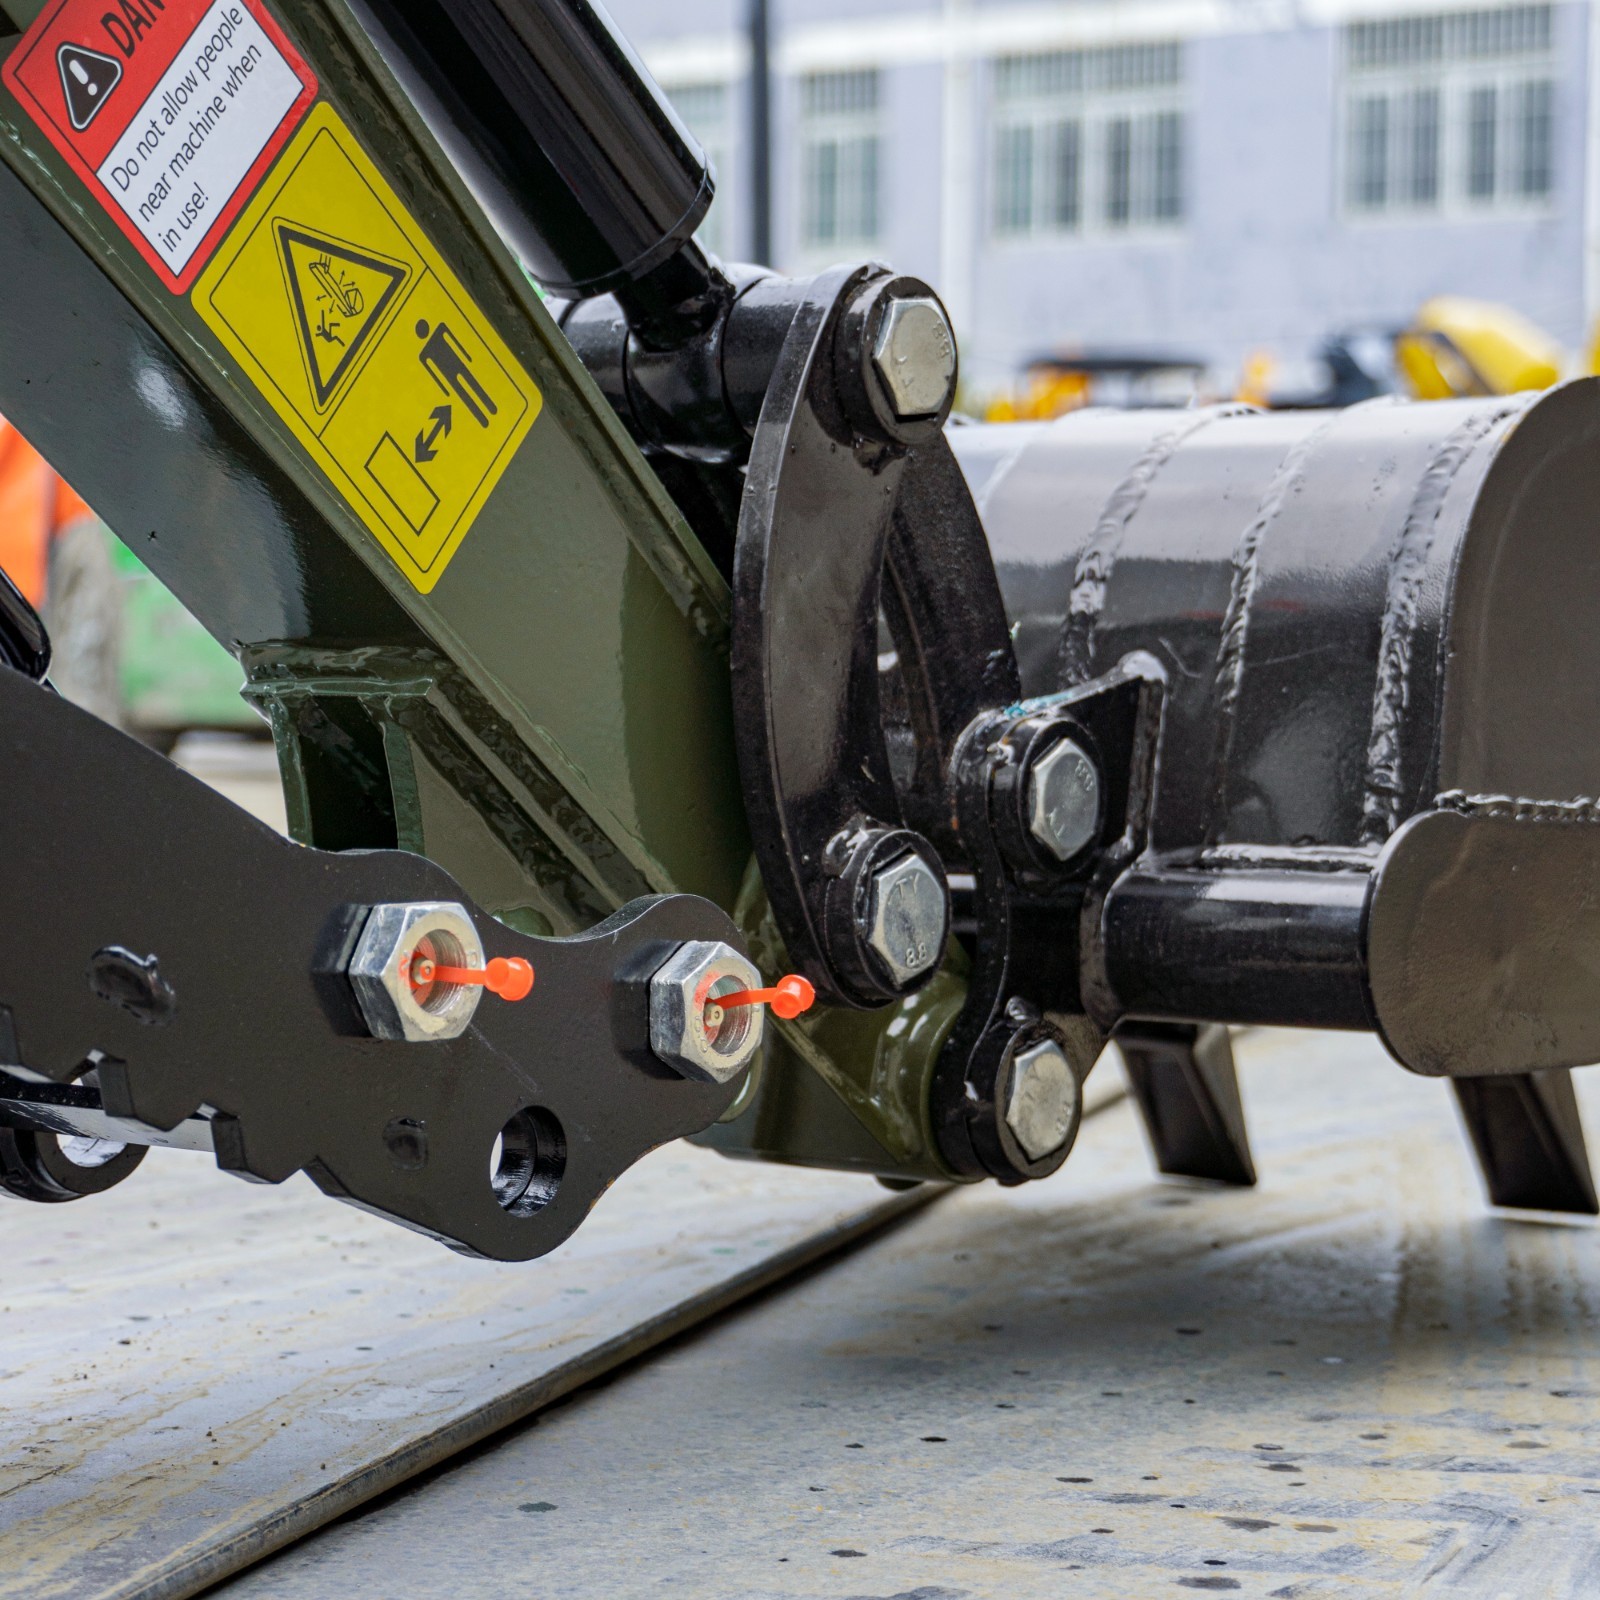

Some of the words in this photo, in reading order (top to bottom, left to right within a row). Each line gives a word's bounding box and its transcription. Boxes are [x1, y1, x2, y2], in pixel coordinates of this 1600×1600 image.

[110, 157, 140, 193] Do
[135, 119, 166, 161] not
[160, 69, 199, 126] allow
[194, 6, 243, 82] people
[138, 172, 172, 223] near
[168, 95, 227, 179] machine
[221, 44, 262, 99] when
[157, 228, 182, 253] in
[176, 181, 209, 231] use!
